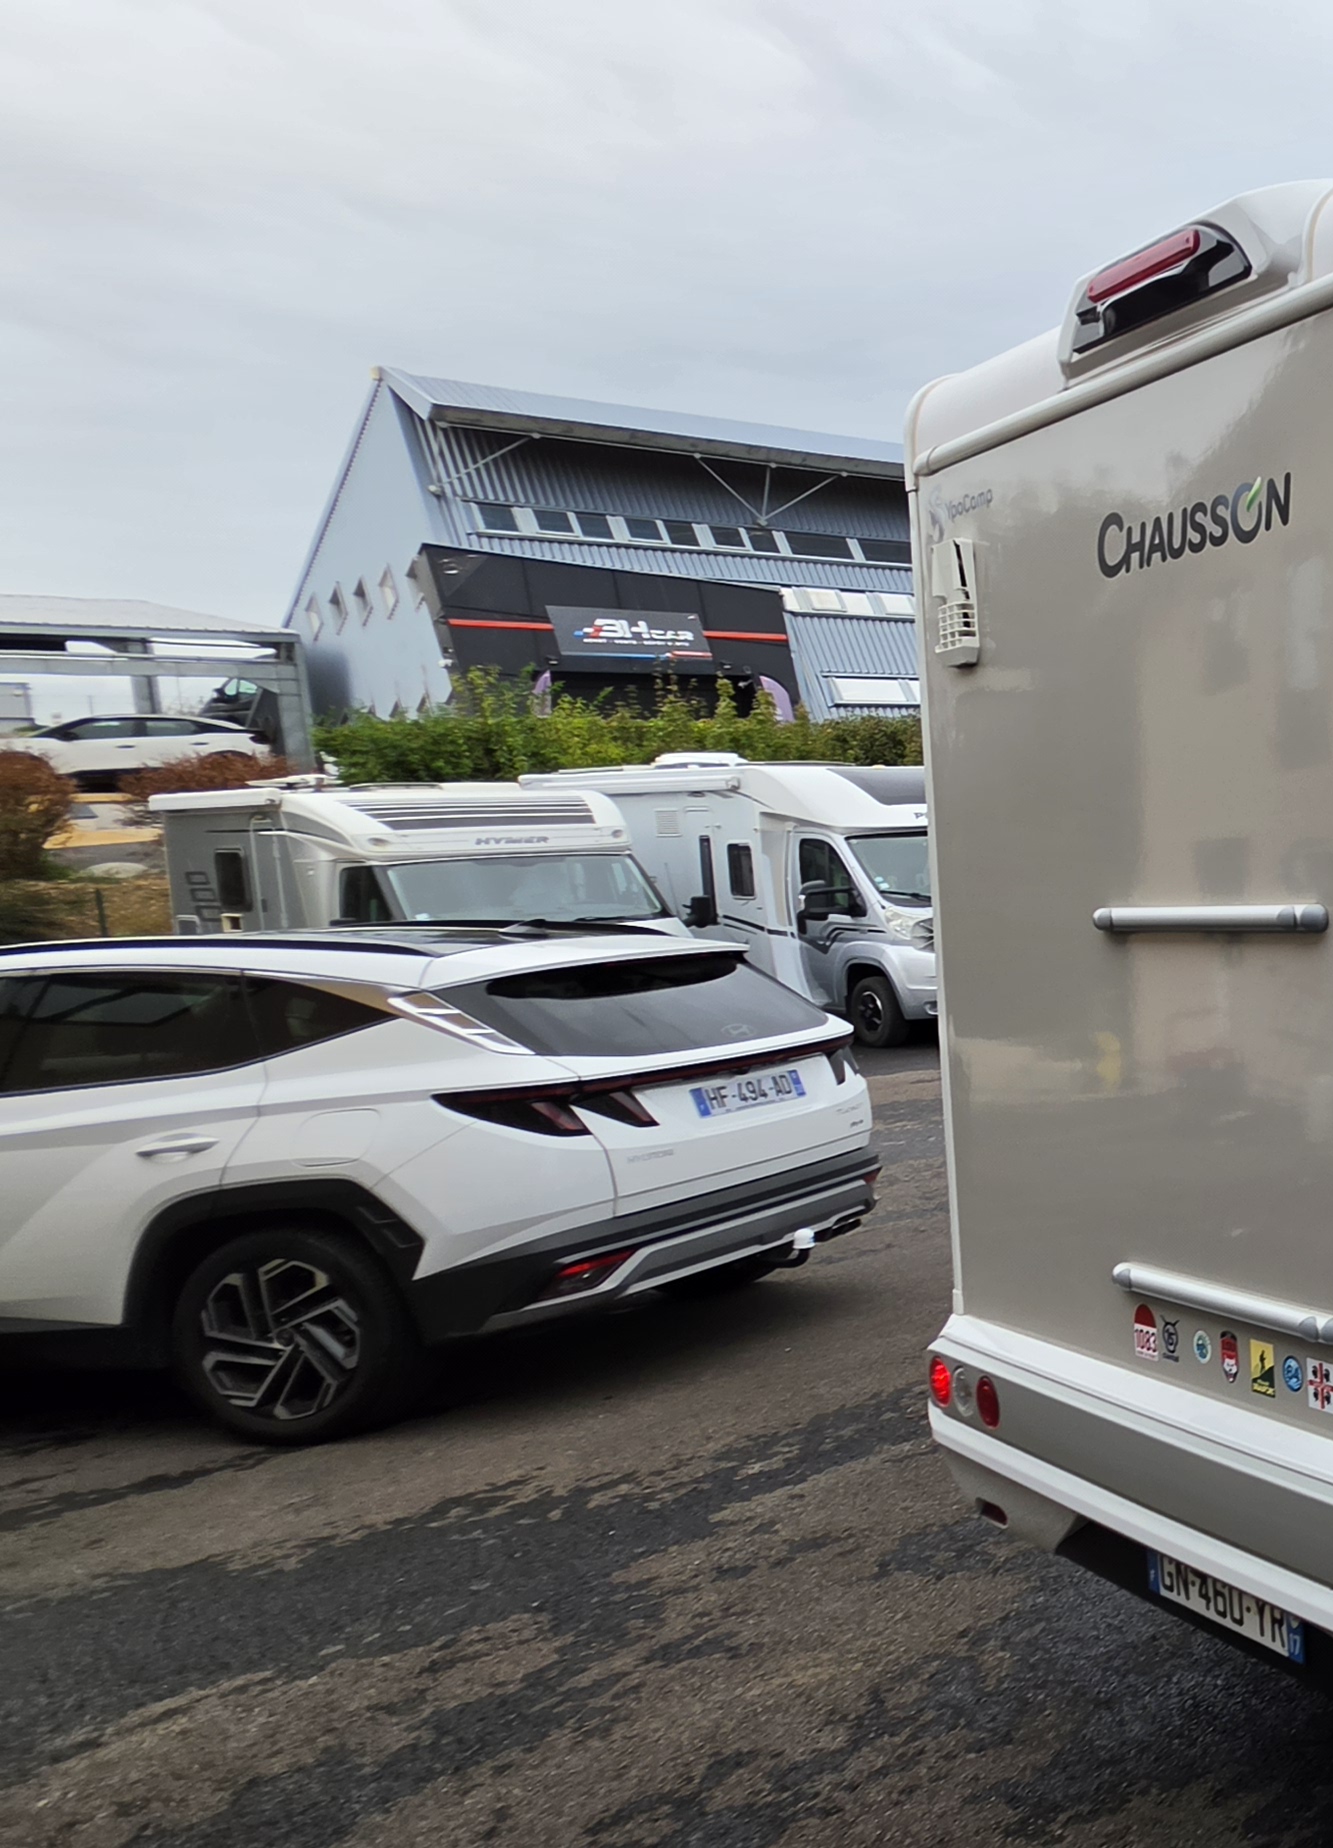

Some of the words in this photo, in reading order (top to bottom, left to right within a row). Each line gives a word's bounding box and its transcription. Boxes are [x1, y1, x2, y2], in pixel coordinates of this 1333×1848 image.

[945, 487, 993, 523] YpoCamp
[1097, 471, 1292, 578] CHAUSSON
[704, 1074, 793, 1110] HF-494-AD
